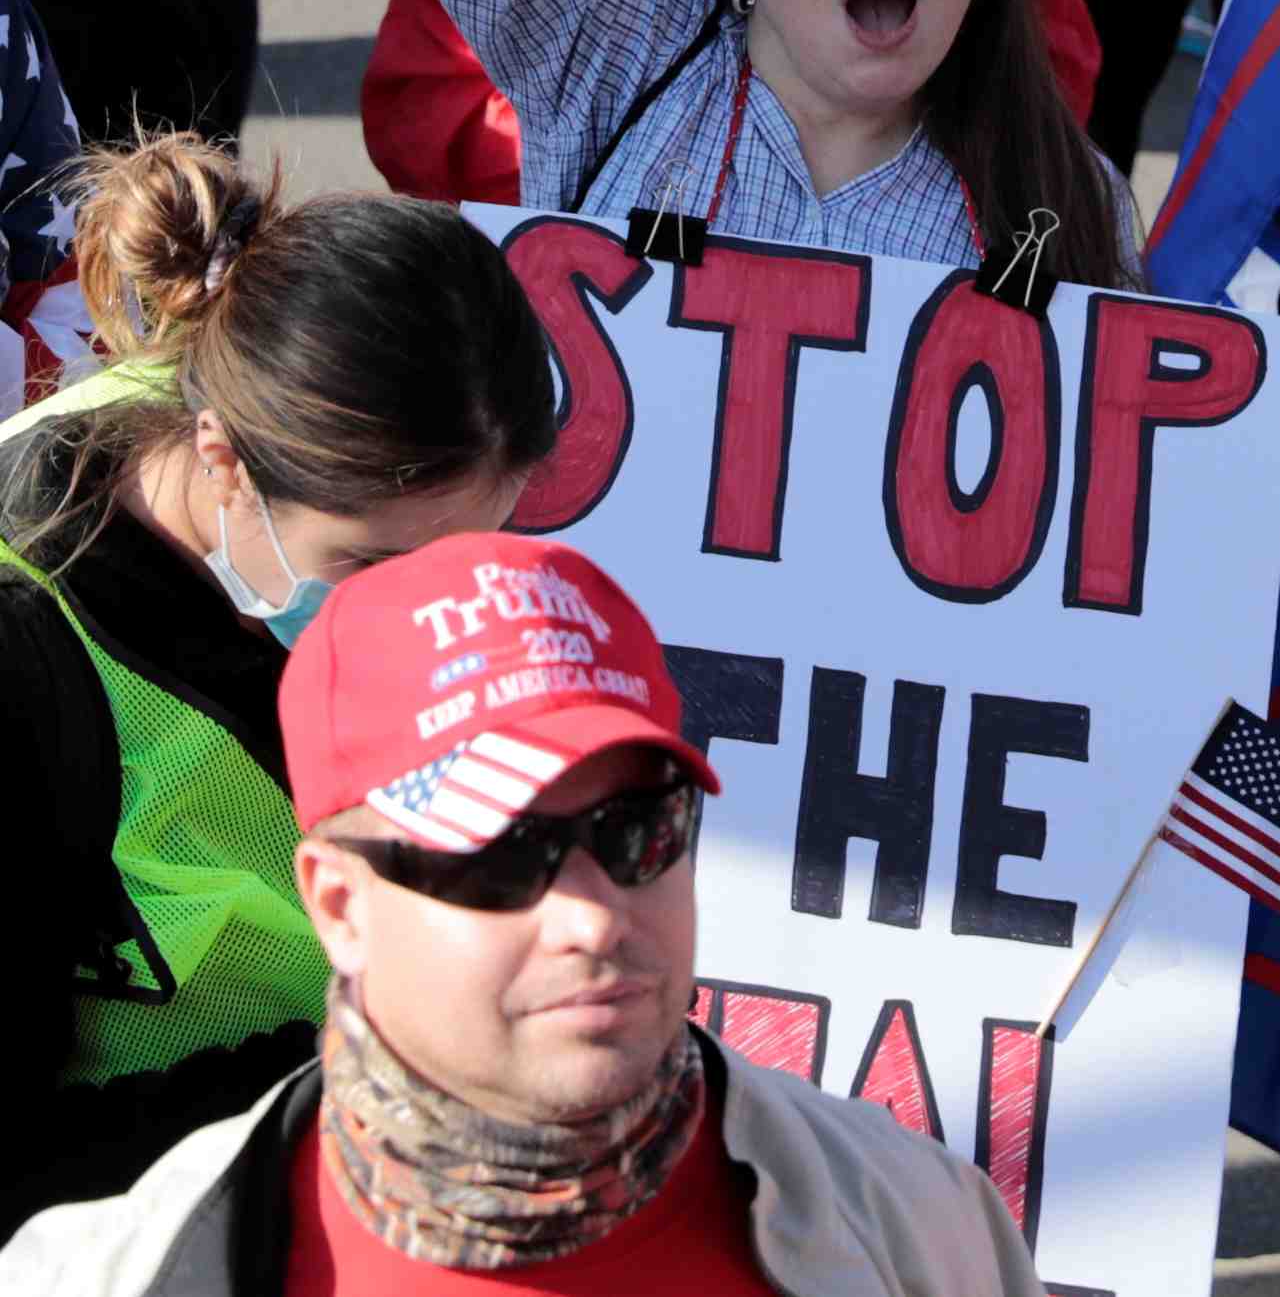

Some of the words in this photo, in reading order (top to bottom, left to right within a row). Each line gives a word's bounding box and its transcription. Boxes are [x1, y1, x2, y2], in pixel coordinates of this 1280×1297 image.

[499, 214, 1268, 616] STOP
[412, 585, 612, 651] Trump
[520, 627, 594, 664] 2020
[415, 690, 477, 740] KEEP
[485, 665, 594, 709] AMERICA
